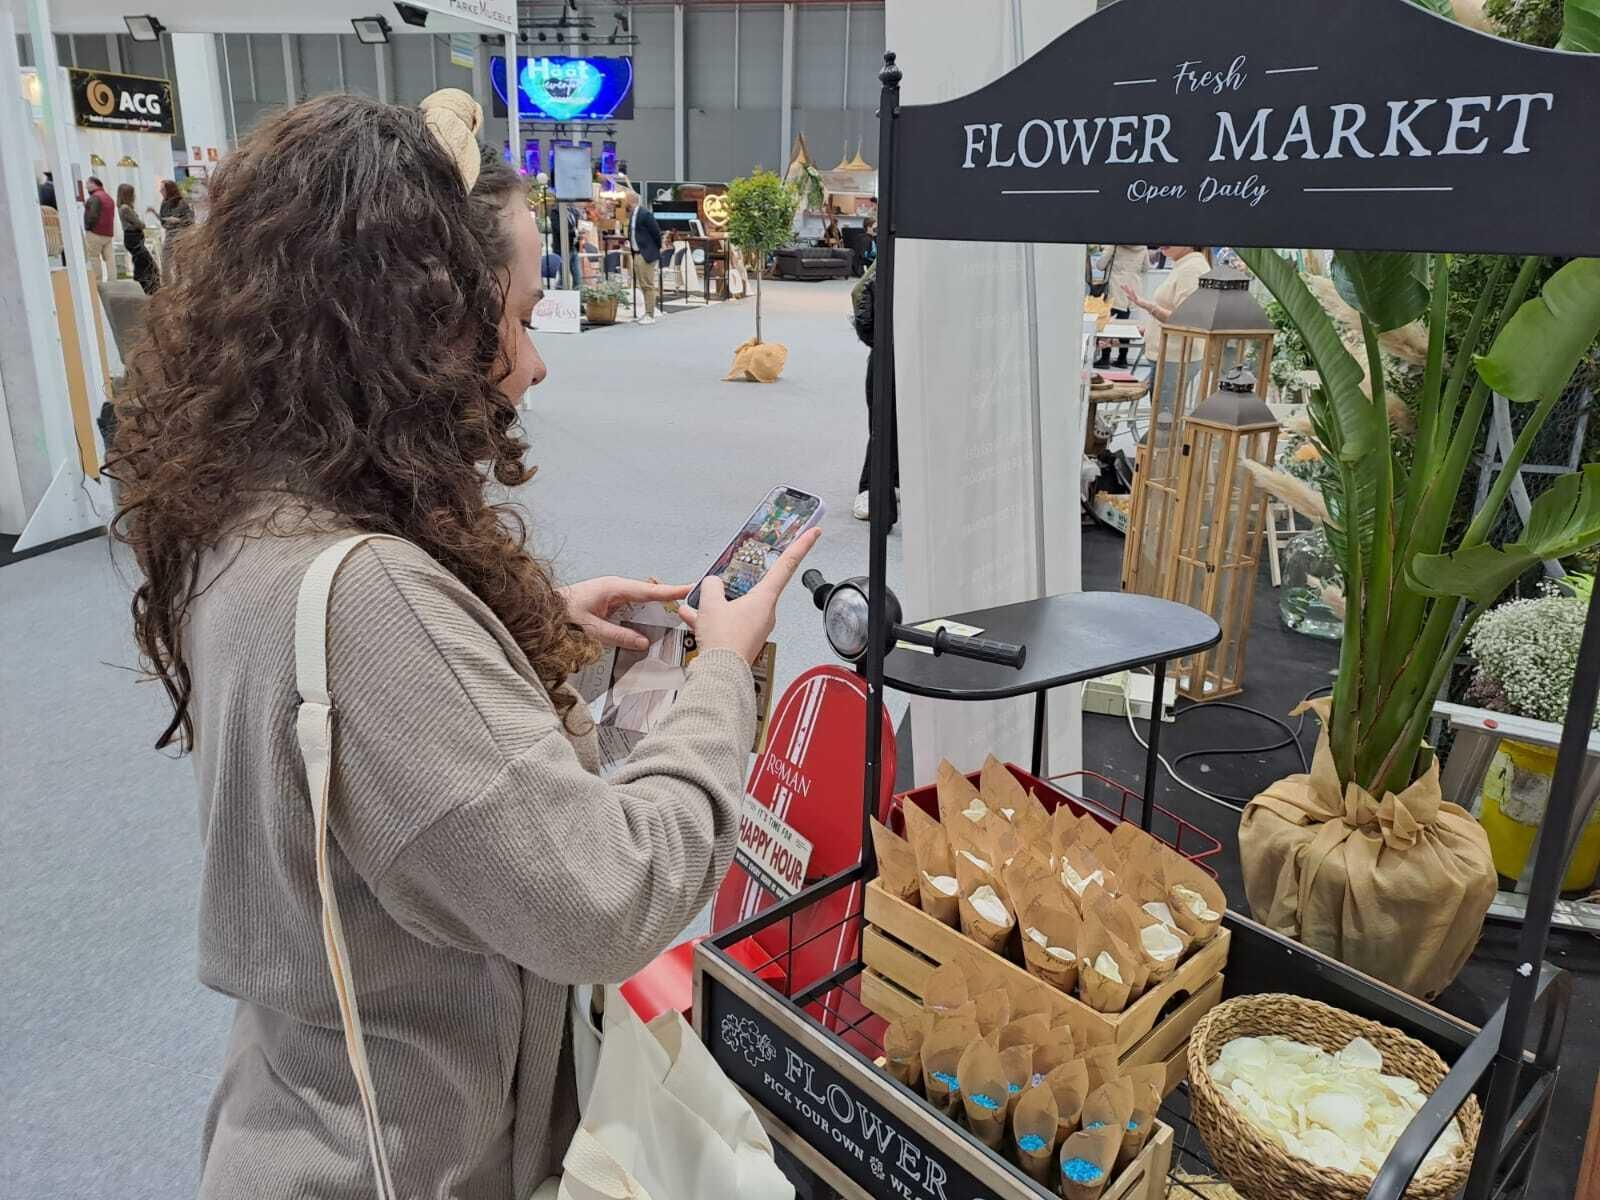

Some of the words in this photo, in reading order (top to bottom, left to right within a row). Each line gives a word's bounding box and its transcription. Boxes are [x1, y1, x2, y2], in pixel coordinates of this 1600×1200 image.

[119, 91, 161, 115] ACG
[1172, 55, 1247, 95] Fresh
[961, 111, 1178, 169] FLOWER
[1209, 91, 1554, 163] MARKET
[1126, 177, 1187, 204] Open
[1198, 174, 1271, 207] Daily
[767, 753, 811, 797] ROMAN
[739, 814, 773, 860] HAPPY
[770, 841, 803, 889] HOUR
[763, 1071, 793, 1104] PICK
[794, 1097, 830, 1134] YOUR
[832, 1128, 864, 1162] OWN
[784, 1046, 948, 1200] FLOWER
